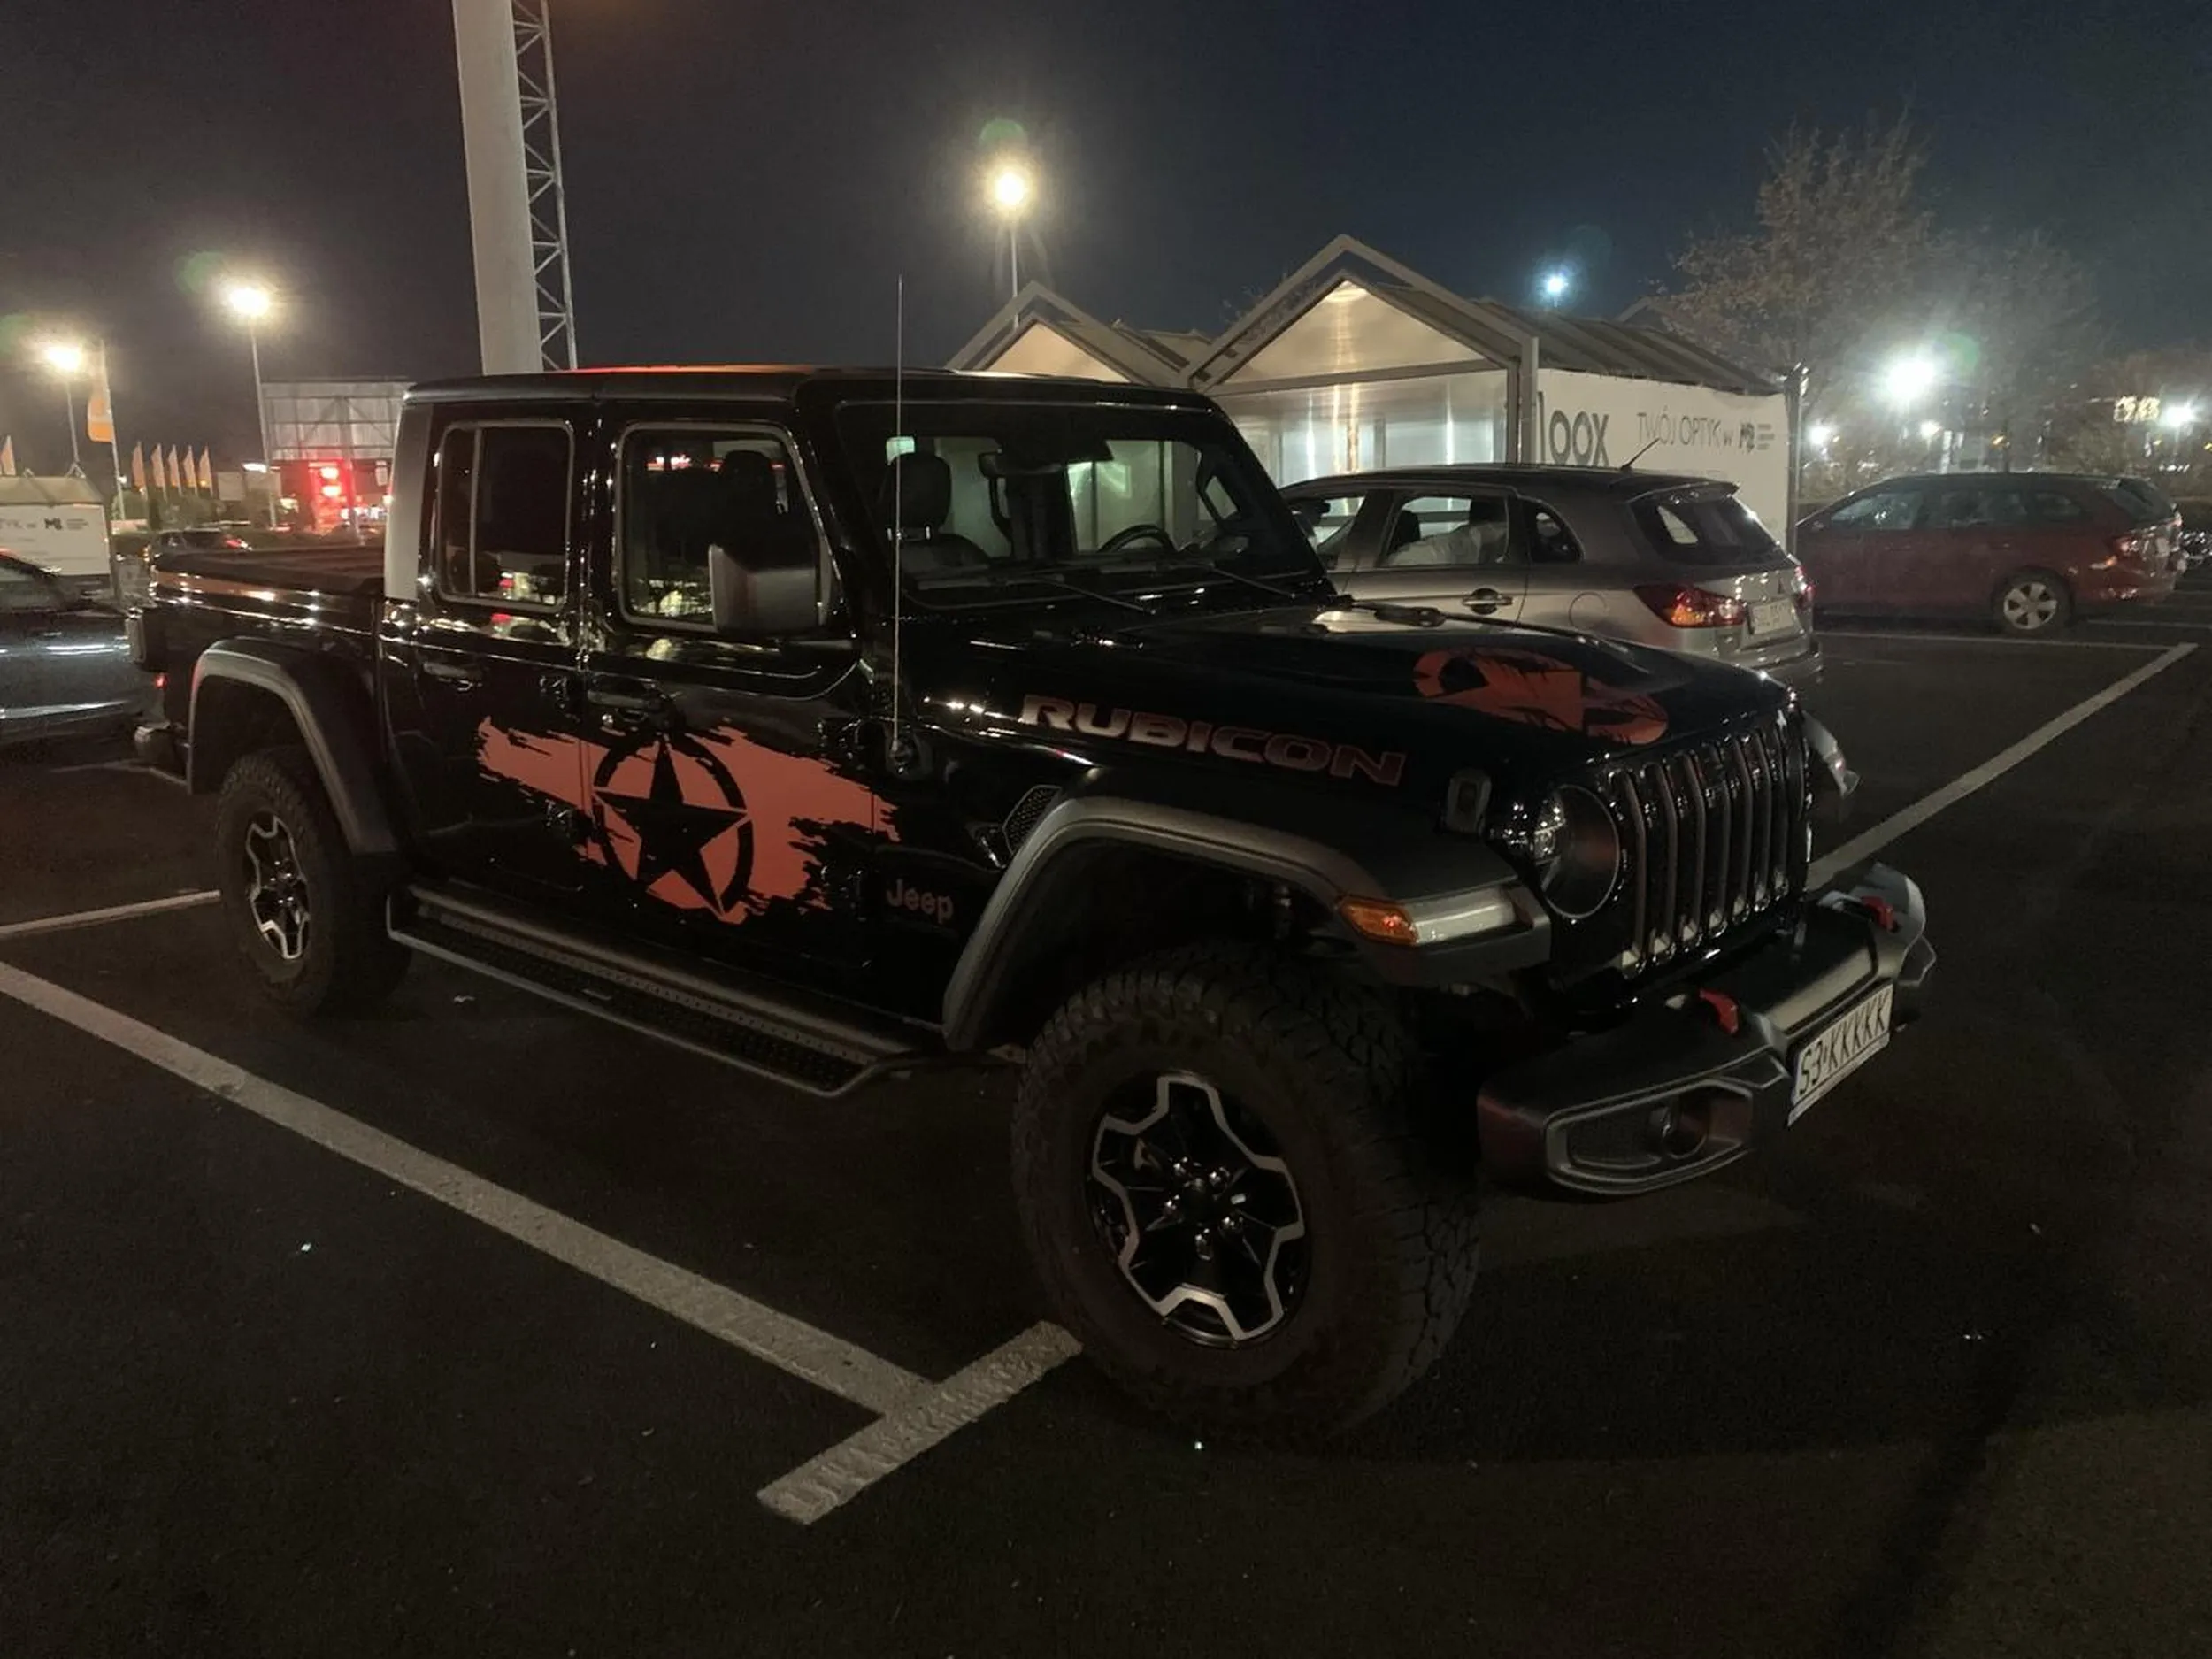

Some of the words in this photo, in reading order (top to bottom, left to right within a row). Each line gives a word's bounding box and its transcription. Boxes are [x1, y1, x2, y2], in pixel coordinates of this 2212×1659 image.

[1637, 404, 1676, 445] TWÓJ
[1680, 415, 1722, 447] OPTYK
[1018, 694, 1406, 787] RUBICON
[886, 878, 955, 925] Jeep
